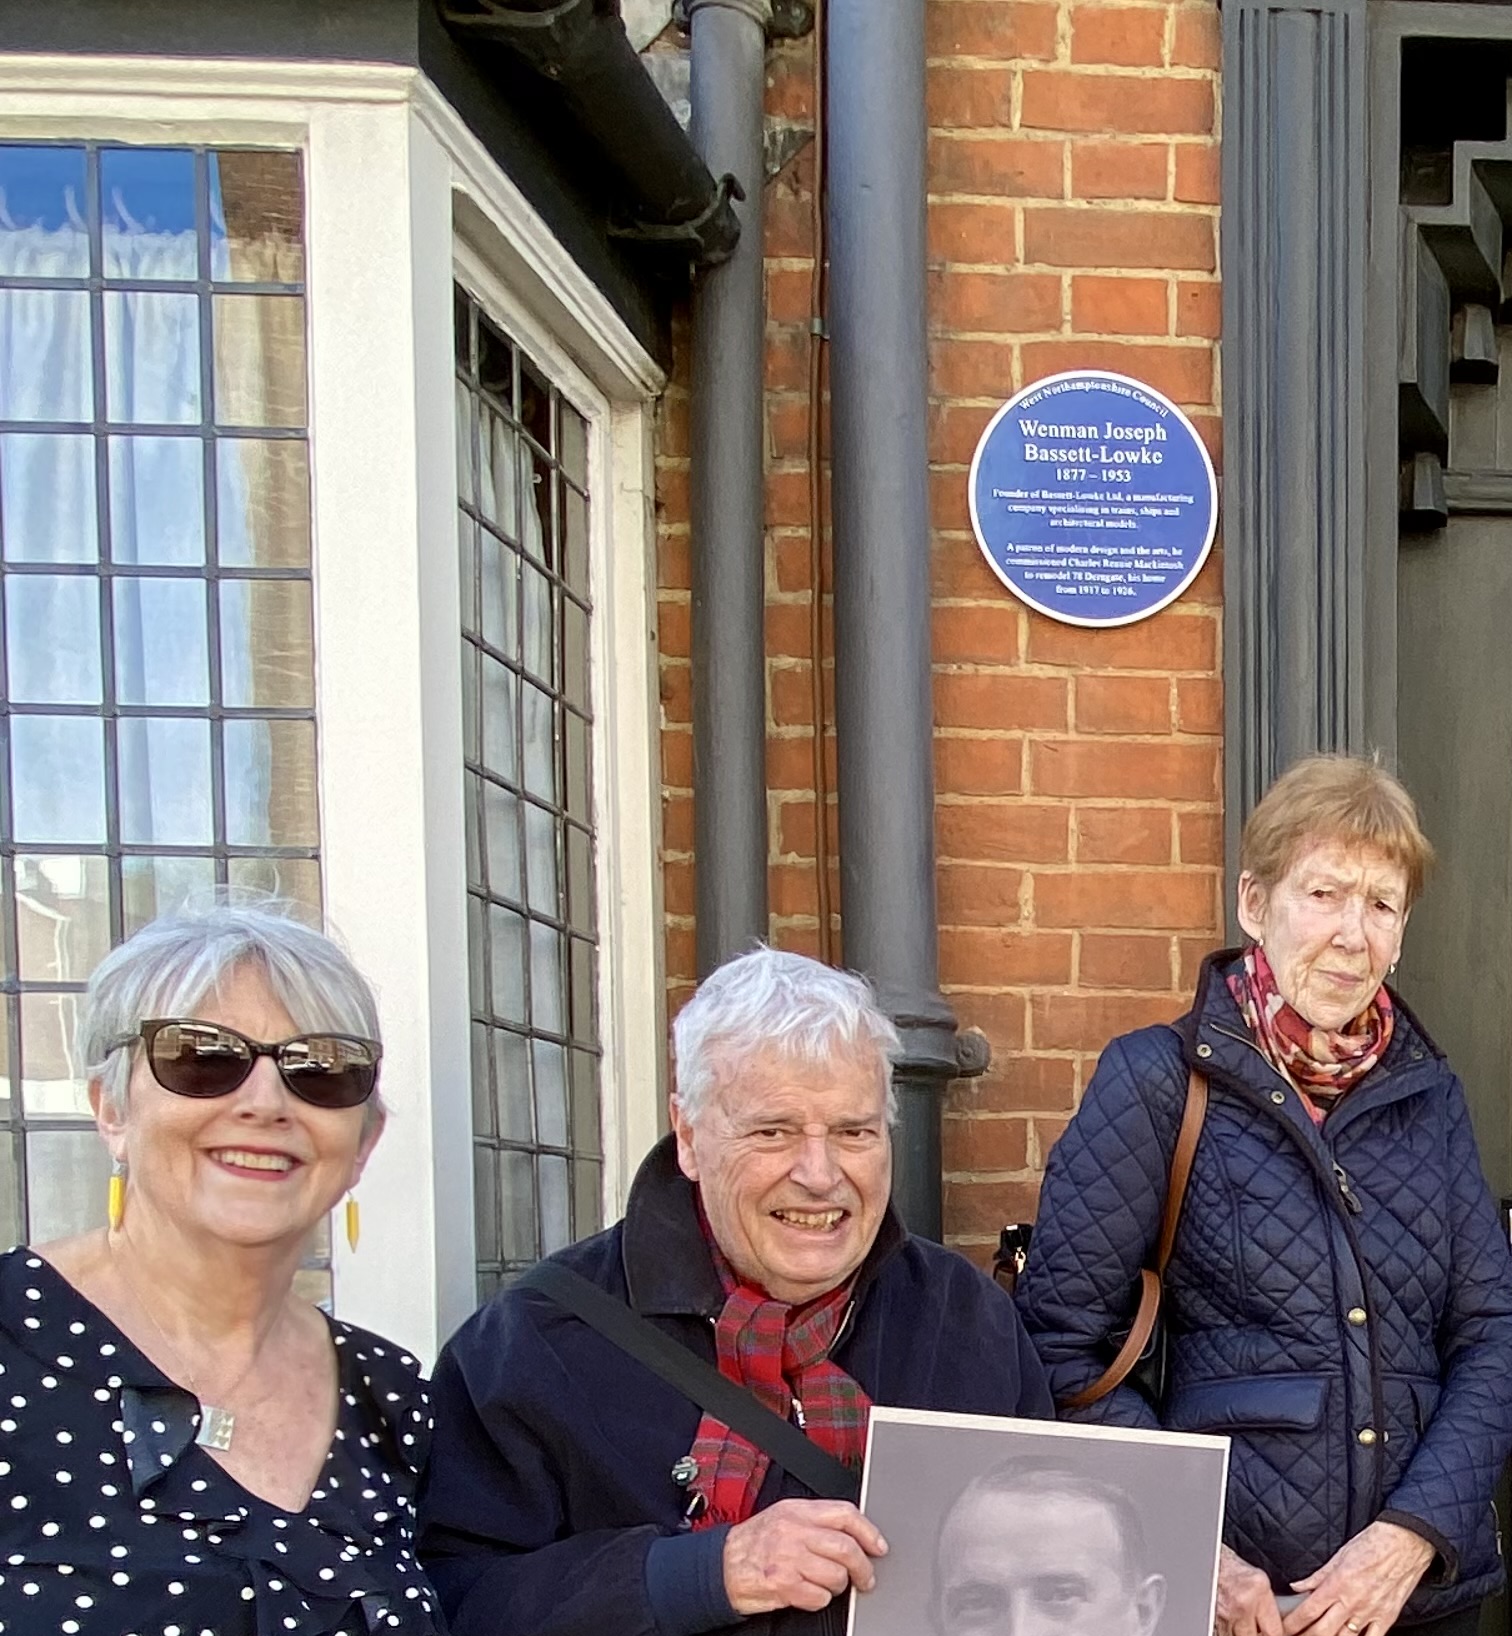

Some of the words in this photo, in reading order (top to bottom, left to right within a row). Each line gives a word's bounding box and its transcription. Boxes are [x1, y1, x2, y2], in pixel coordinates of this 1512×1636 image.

[1019, 393, 1043, 410] West
[1132, 390, 1169, 417] Council
[1018, 419, 1099, 439] Wenman
[1103, 422, 1168, 445] Joseph
[1024, 443, 1163, 464] Bassett-Lowke
[1056, 468, 1087, 481] 1877
[1101, 469, 1132, 482] 1953
